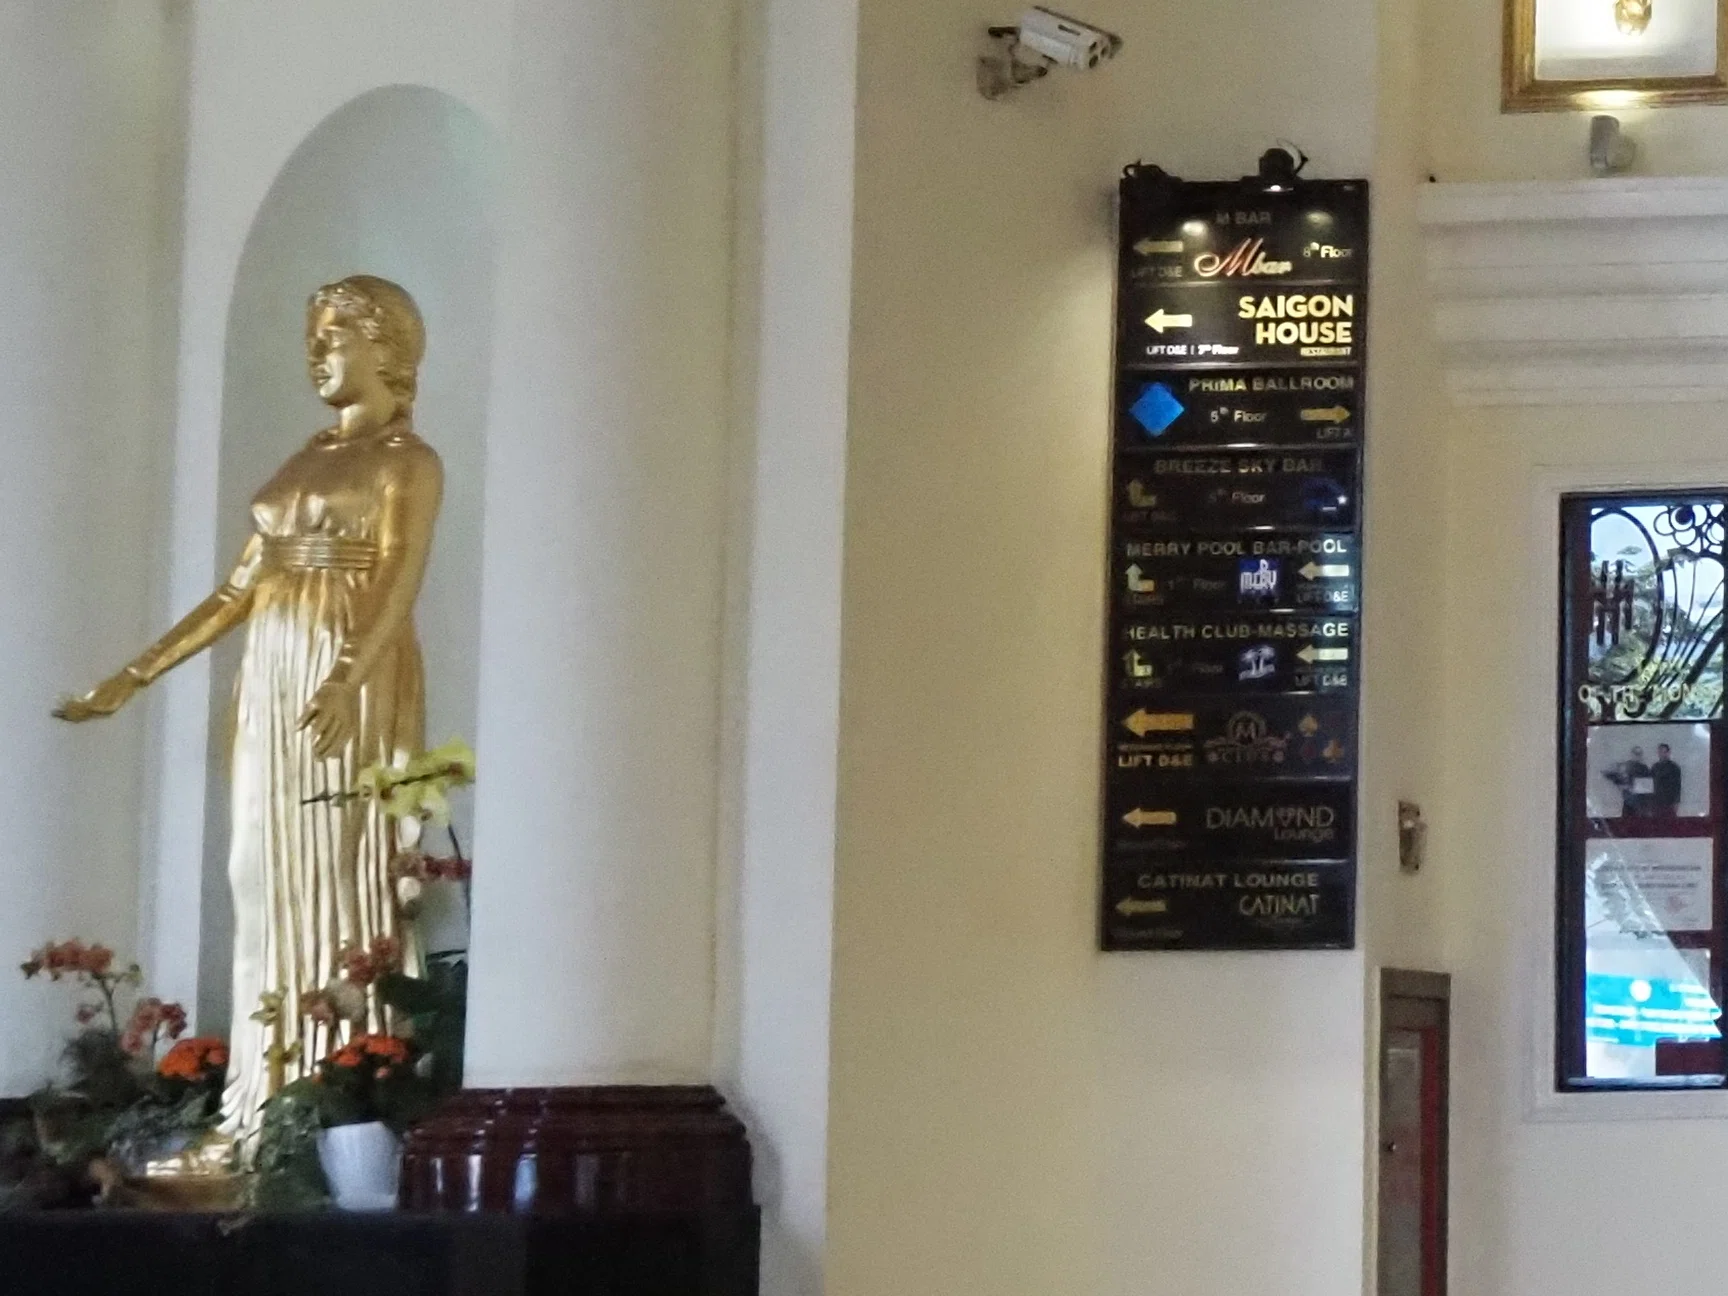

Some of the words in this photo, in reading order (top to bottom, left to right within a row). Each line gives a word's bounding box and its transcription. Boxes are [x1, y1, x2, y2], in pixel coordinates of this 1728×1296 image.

[1238, 294, 1353, 318] SAIGON
[1255, 322, 1352, 344] HOUSE
[1188, 377, 1247, 392] PRIMA
[1252, 376, 1354, 391] BALLROOM
[1126, 541, 1190, 556] MERRY
[1198, 540, 1245, 555] POOL
[1138, 874, 1227, 889] CATINAT
[1234, 873, 1319, 887] LOUNGE
[1238, 894, 1319, 916] CATINAT
